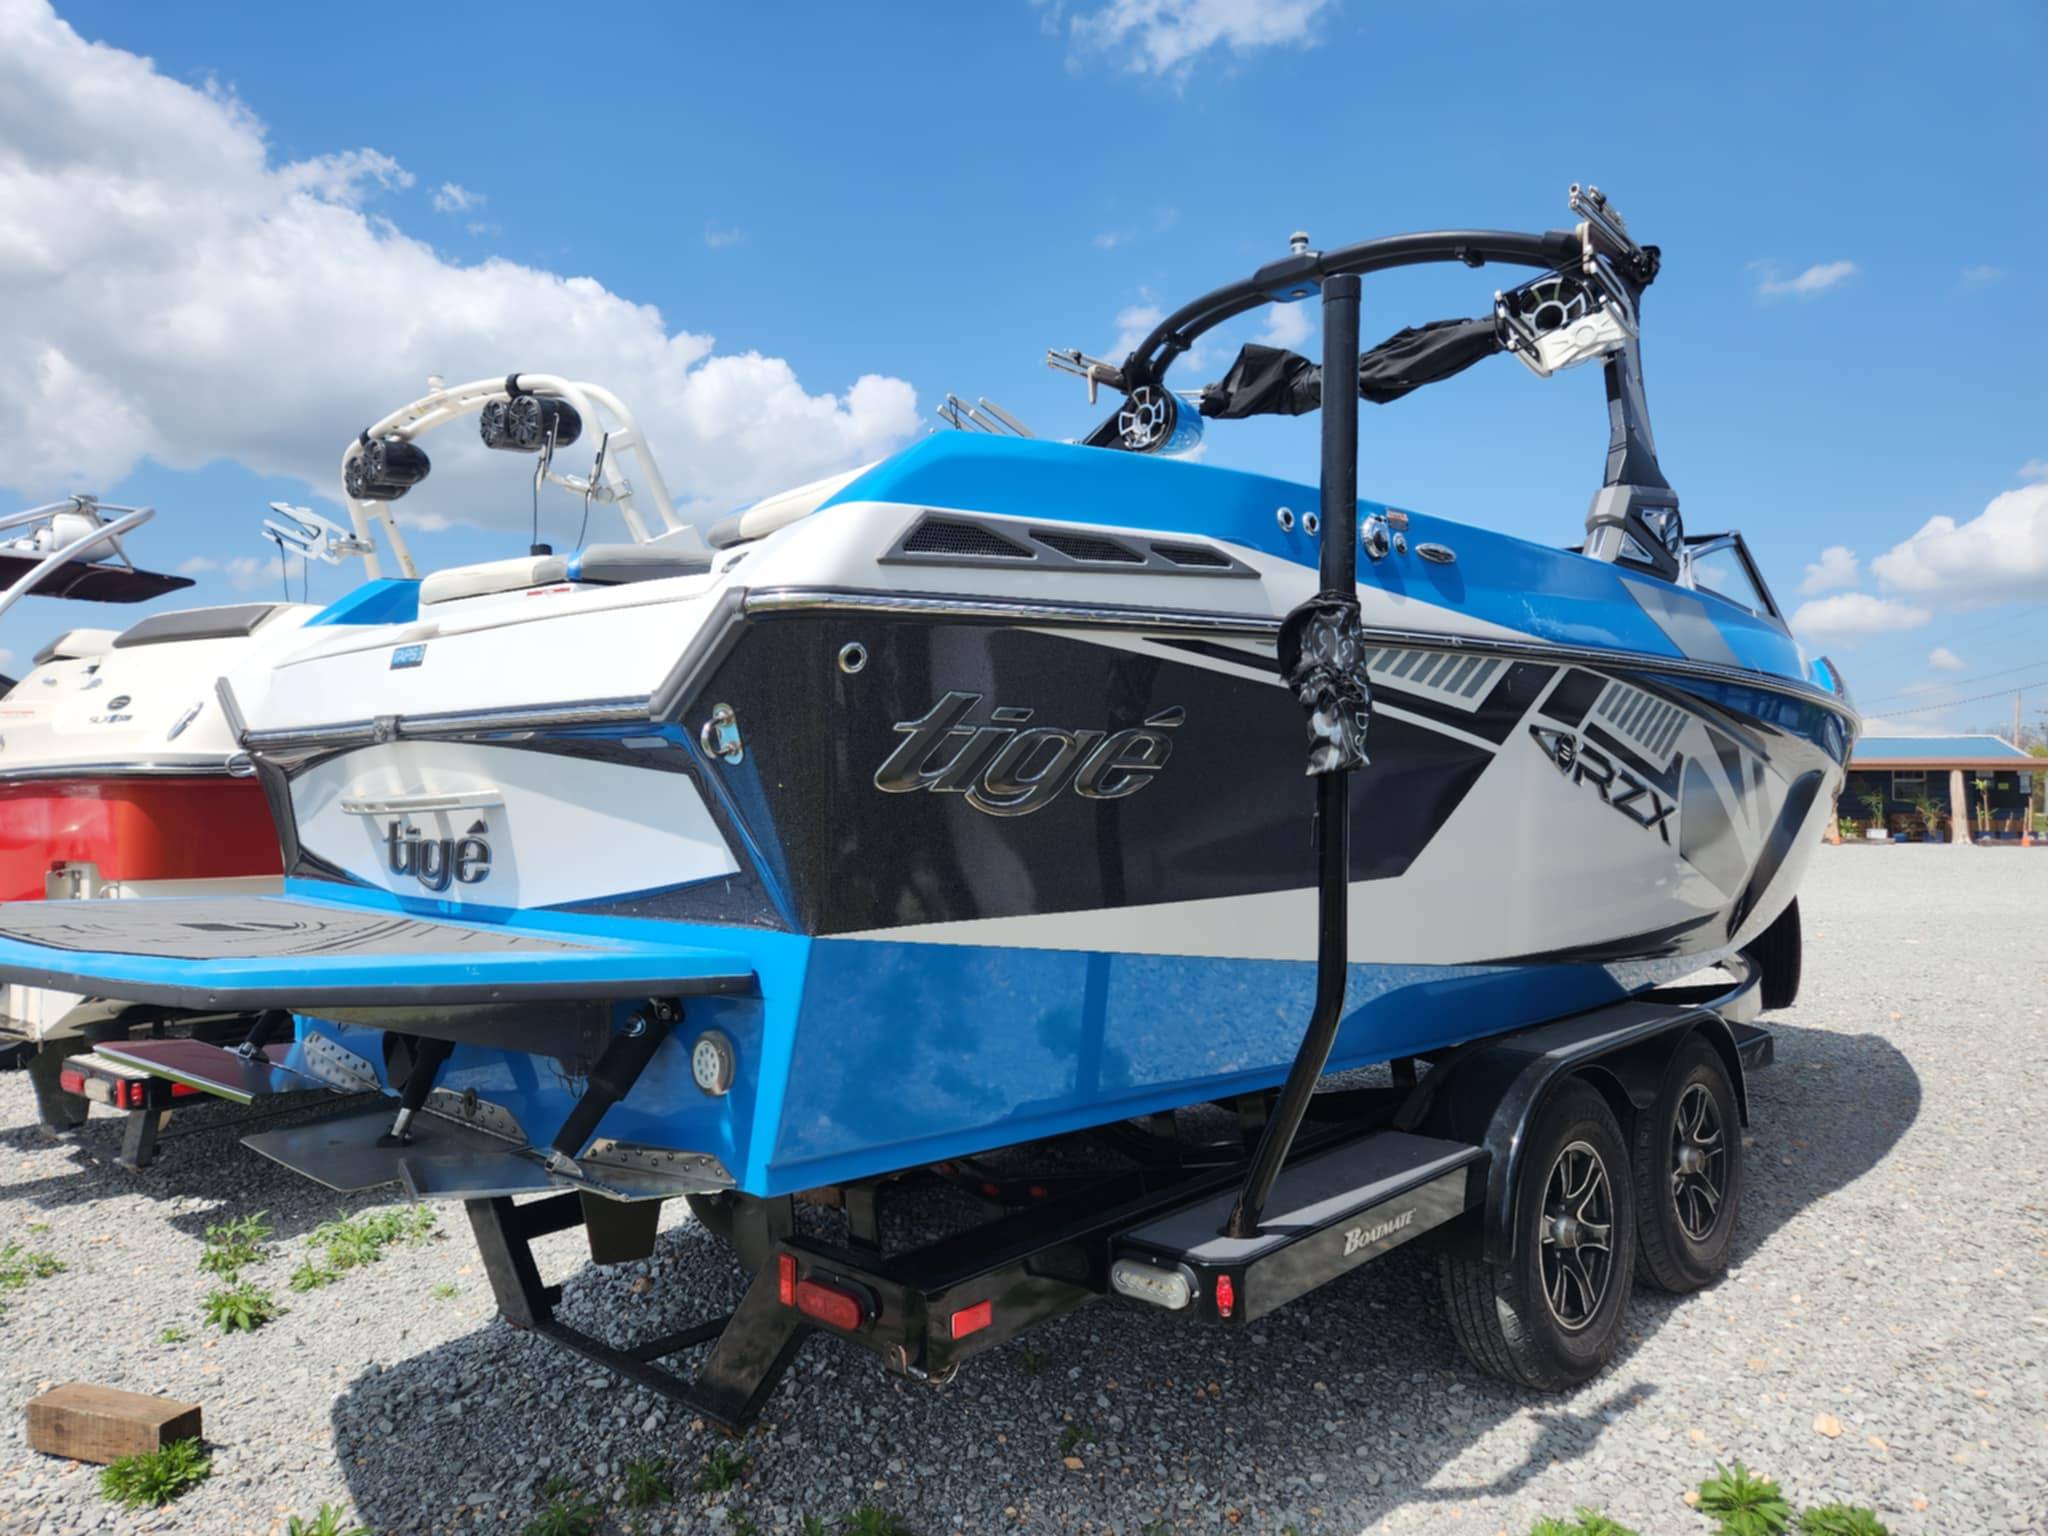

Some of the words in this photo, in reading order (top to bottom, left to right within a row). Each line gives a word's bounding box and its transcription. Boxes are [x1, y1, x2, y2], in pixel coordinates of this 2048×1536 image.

[873, 691, 1186, 817] tigé
[1574, 742, 1677, 846] RZX
[383, 819, 492, 893] tigé
